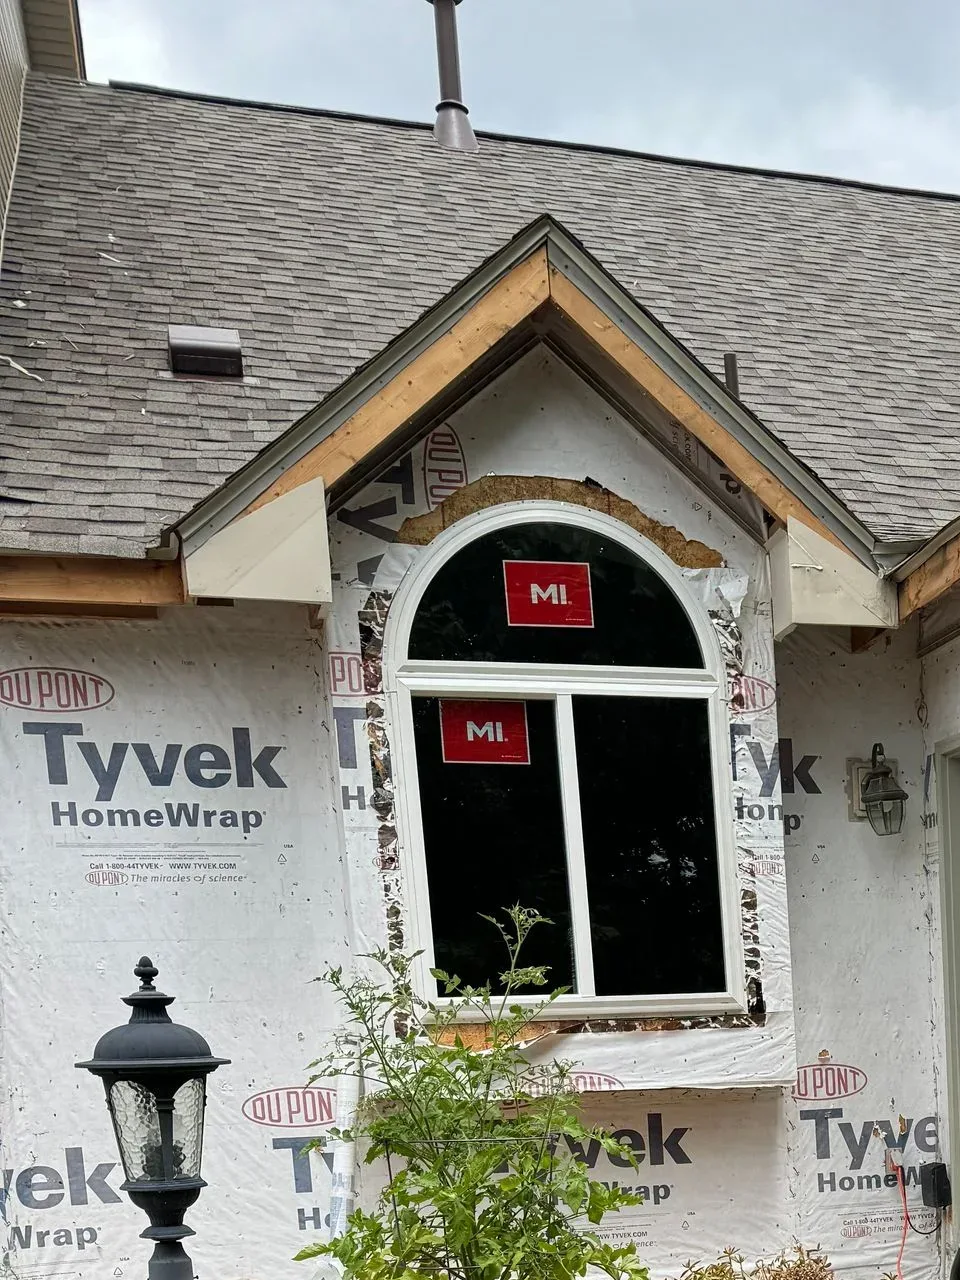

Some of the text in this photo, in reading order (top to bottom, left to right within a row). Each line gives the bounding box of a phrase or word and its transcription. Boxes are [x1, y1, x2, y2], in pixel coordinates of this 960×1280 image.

[530, 583, 567, 605] MI
[466, 720, 503, 742] MI
[22, 721, 288, 802] Tyvek
[51, 801, 264, 834] HomeWrap
[89, 862, 104, 870] Call
[131, 873, 149, 883] The
[150, 873, 191, 883] miracles
[194, 873, 207, 885] of
[208, 873, 244, 883] science
